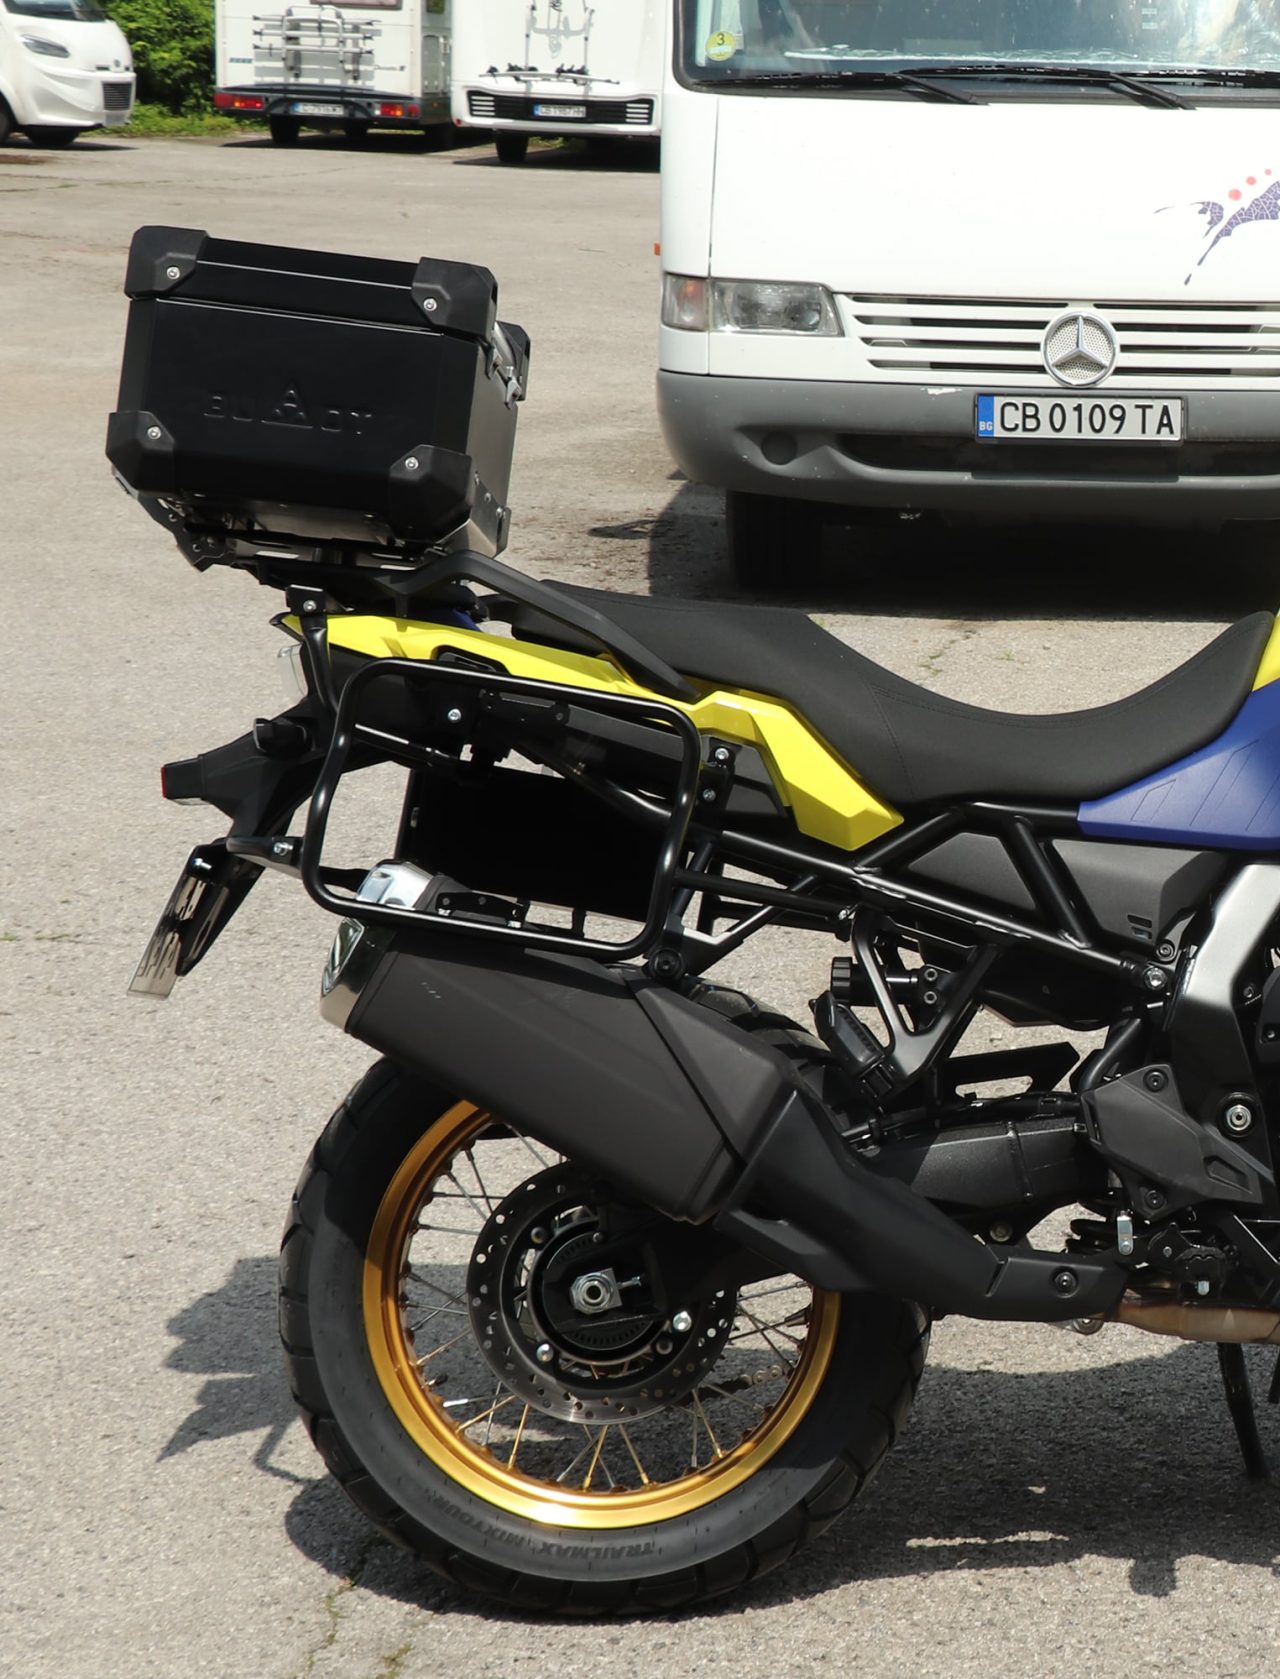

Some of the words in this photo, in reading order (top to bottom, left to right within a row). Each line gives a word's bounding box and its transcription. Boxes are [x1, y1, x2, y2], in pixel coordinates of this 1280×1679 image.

[717, 32, 725, 46] 3
[979, 420, 994, 432] BG
[1000, 401, 1042, 433] CB
[1049, 402, 1127, 434] 0109
[1134, 404, 1175, 435] TA
[538, 1541, 654, 1561] TRAILMAX
